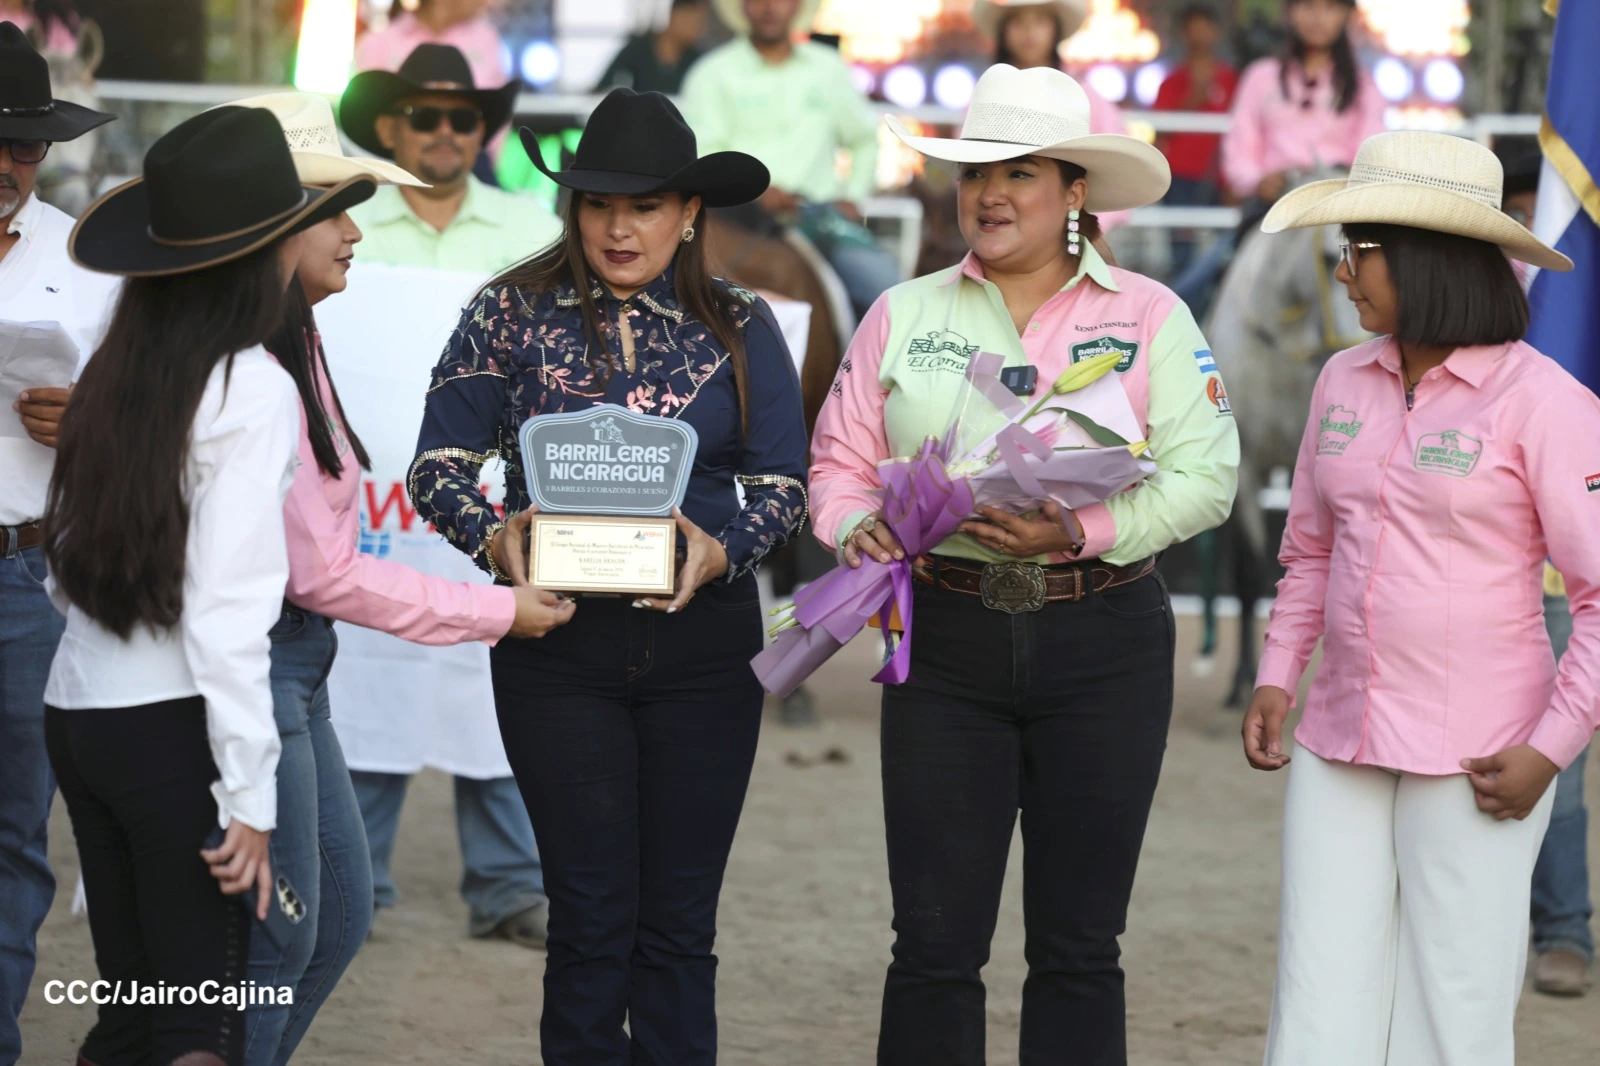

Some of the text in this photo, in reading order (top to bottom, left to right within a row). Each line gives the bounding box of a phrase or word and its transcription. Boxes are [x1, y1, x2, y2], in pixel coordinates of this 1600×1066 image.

[1074, 321, 1138, 332] KENIA CISNEROS
[908, 355, 967, 369] El Corra
[545, 443, 671, 463] BARRILERAS
[549, 463, 665, 483] NICARAGUA
[550, 485, 585, 493] BARRILES
[642, 487, 668, 495] SUEÑO
